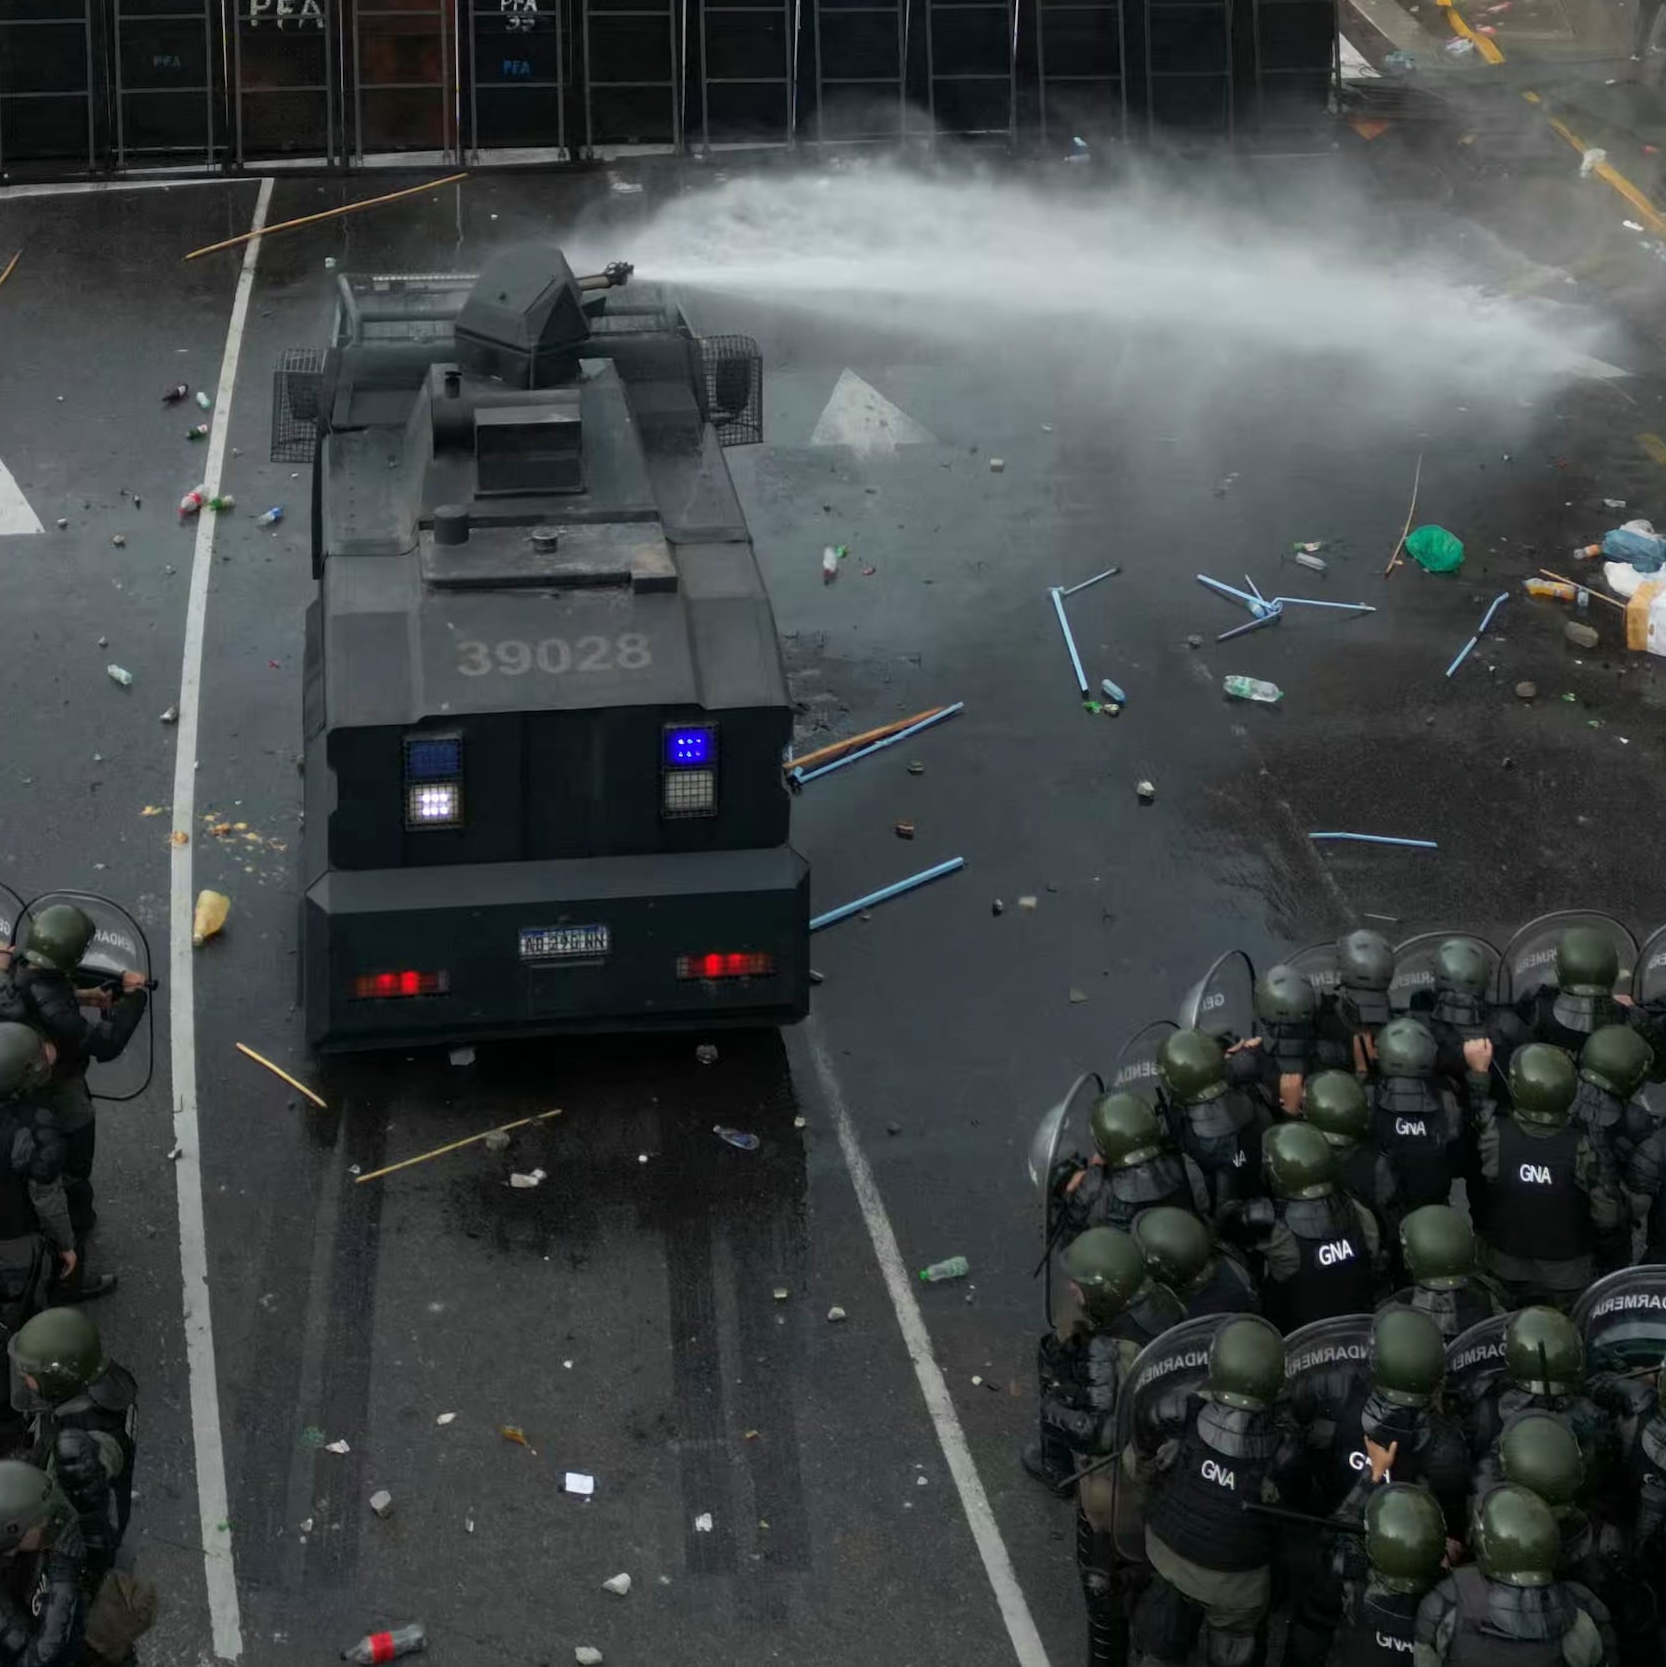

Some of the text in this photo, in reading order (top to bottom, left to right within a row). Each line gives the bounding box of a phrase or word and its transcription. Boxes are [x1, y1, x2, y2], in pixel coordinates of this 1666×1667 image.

[457, 634, 654, 678] 39028
[1396, 1118, 1426, 1136] GNA
[1519, 1164, 1552, 1185] GNA
[1319, 1239, 1354, 1266] GNA
[1201, 1459, 1235, 1490] GNA
